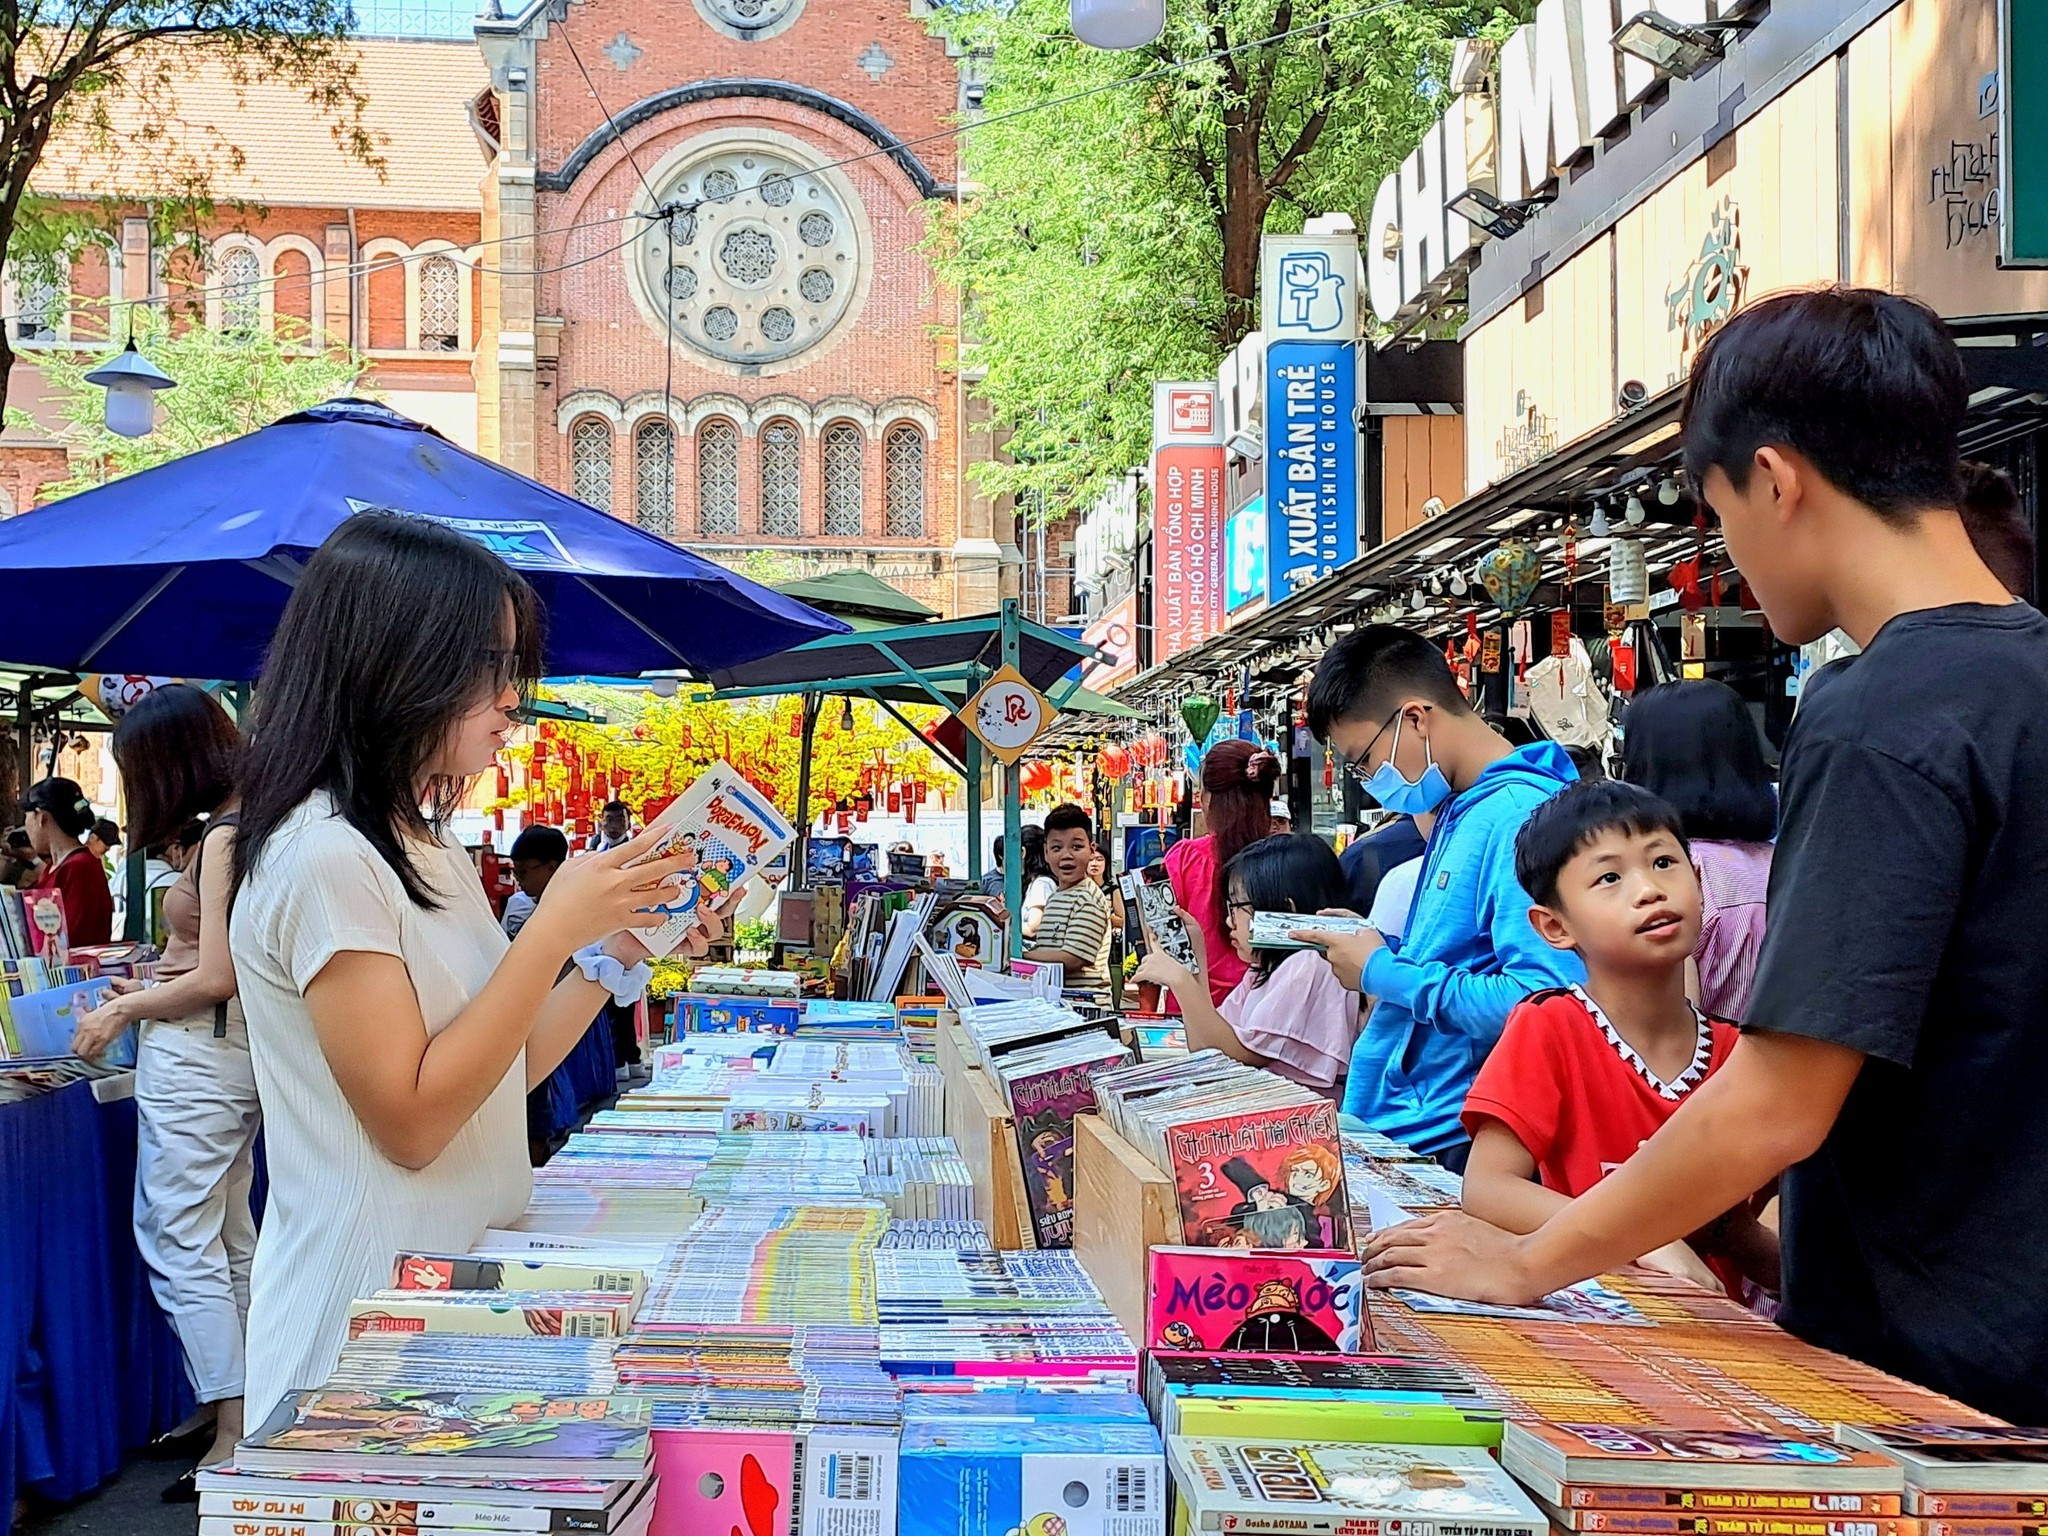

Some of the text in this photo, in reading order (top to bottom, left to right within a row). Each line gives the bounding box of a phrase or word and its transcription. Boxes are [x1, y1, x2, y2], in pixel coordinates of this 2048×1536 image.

[1277, 365, 1316, 417] TRẺ
[1279, 422, 1317, 484] BẢN
[1321, 361, 1338, 577] PUBLISHING HOUSE
[1168, 466, 1186, 497] HỢP
[1191, 468, 1205, 508] MINH
[1210, 468, 1219, 493] HOUSE
[1161, 504, 1184, 547] TỔNG
[1187, 511, 1205, 541] CHÍ
[1210, 494, 1219, 549] PUBLISHING
[1279, 487, 1317, 557] XUẤT
[1163, 552, 1183, 583] BẢN
[1185, 543, 1205, 568] HỒ
[1210, 550, 1219, 589] GENERAL
[1185, 570, 1204, 604] PHỐ
[1210, 590, 1219, 609] CITY
[1163, 588, 1183, 628] XUẤT
[1197, 1162, 1216, 1190] 3
[1166, 1272, 1250, 1317] Mèo
[1272, 1520, 1308, 1529] AOYAMA
